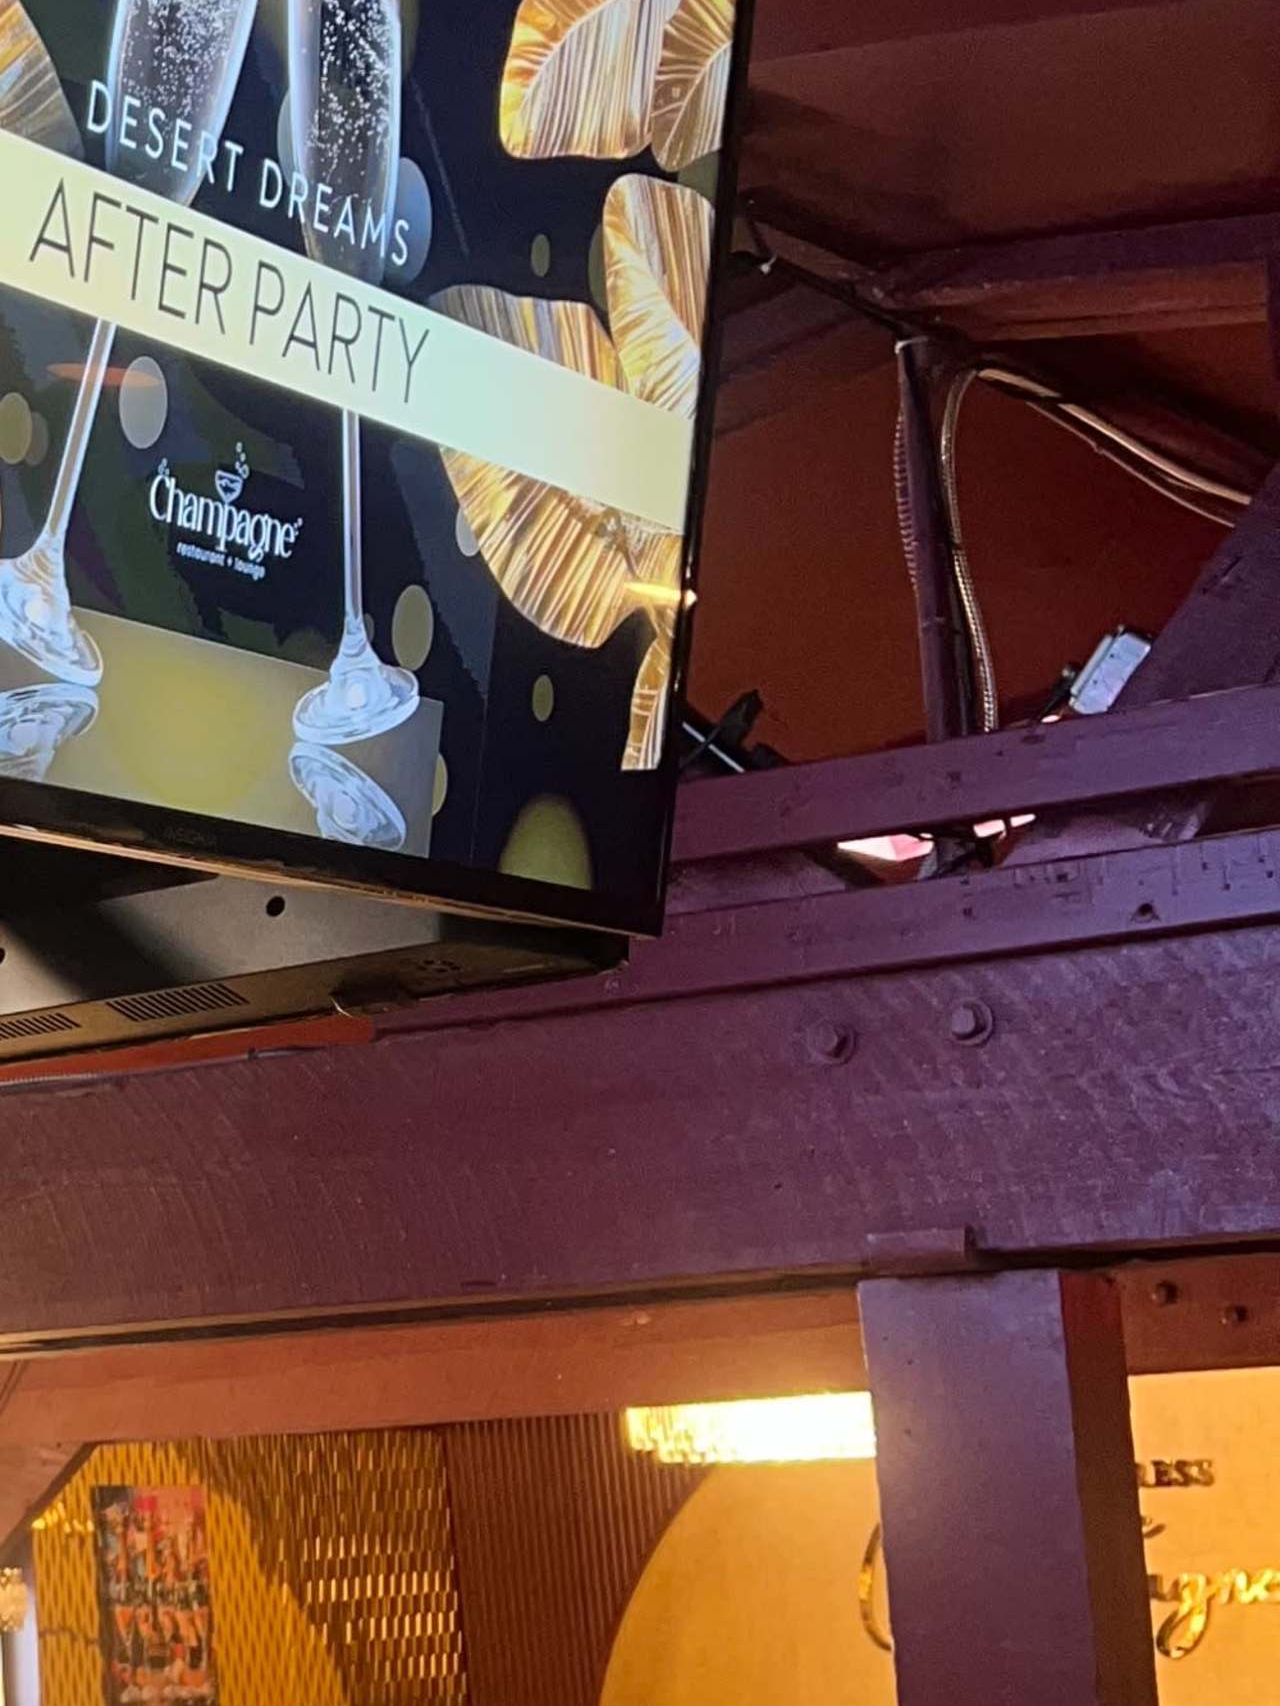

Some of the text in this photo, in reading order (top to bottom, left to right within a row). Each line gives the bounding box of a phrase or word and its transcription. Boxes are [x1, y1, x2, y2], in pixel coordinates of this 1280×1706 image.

[86, 79, 411, 267] DESERT DREAMS
[29, 177, 430, 403] AFTER PARTY
[149, 474, 296, 562] Champagne
